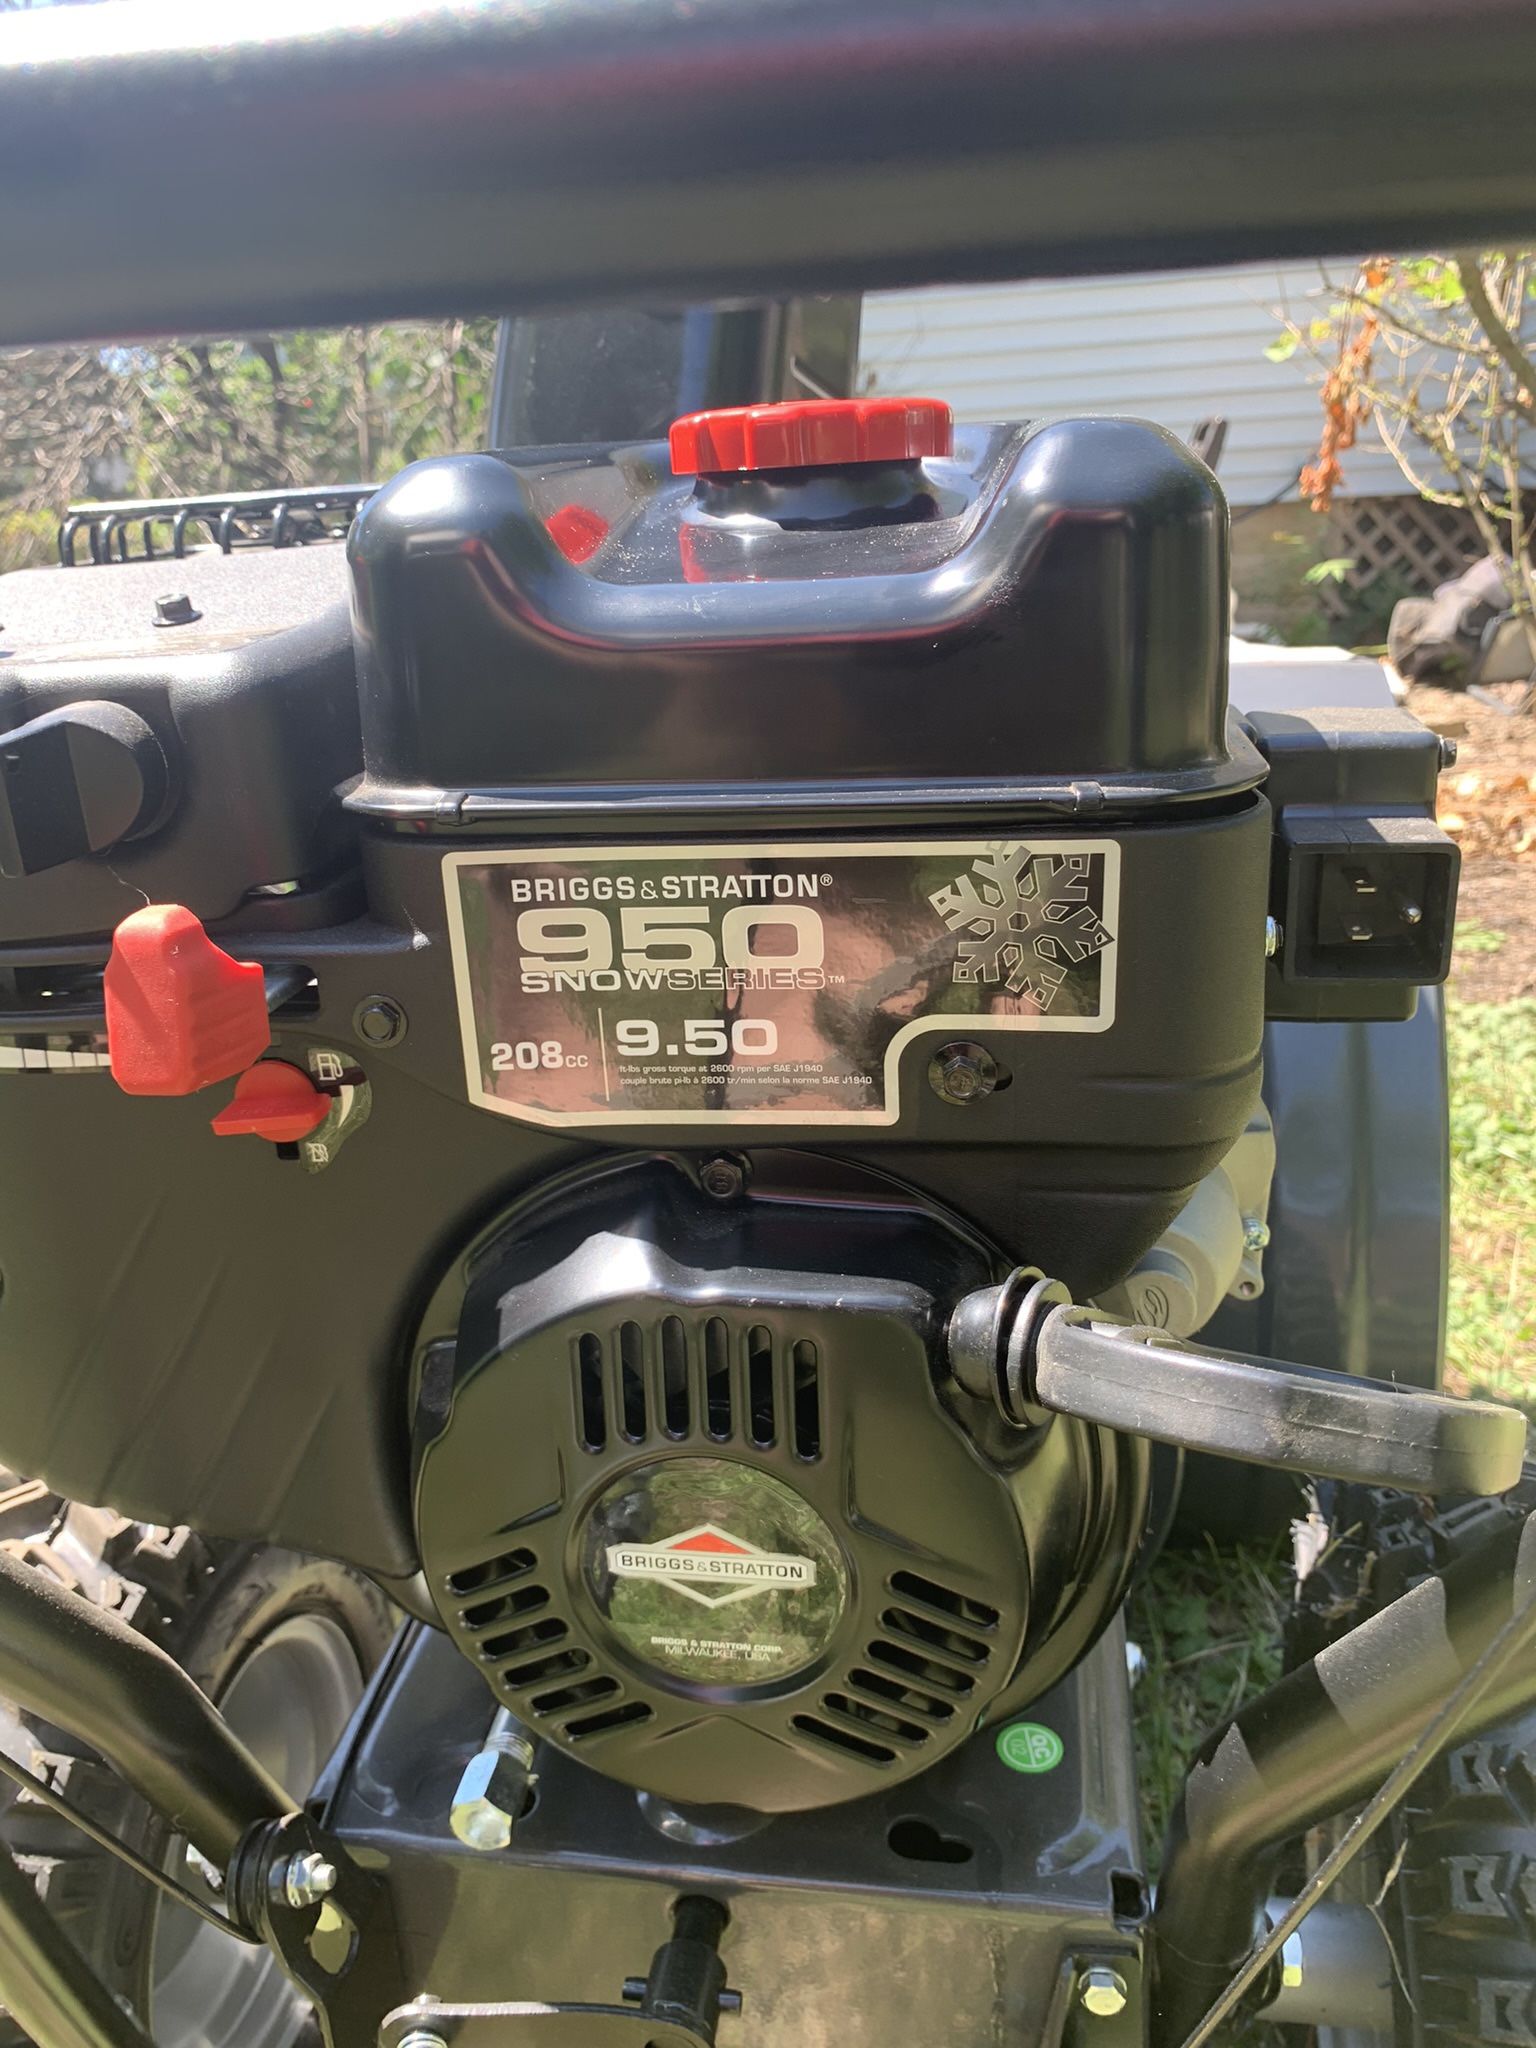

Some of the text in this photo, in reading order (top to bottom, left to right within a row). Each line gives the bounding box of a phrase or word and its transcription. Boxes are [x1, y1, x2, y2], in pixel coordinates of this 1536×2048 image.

[516, 904, 825, 977] 950
[615, 1019, 778, 1057] 9.50
[668, 1066, 696, 1074] torque
[698, 1065, 708, 1073] at
[710, 1064, 735, 1073] 2600
[736, 1066, 755, 1074] rpm
[756, 1066, 771, 1074] per
[773, 1064, 791, 1073] SAE
[793, 1064, 823, 1073] J1940
[620, 1077, 648, 1086] couple
[649, 1077, 672, 1085] brute
[701, 1076, 725, 1085] 2600
[727, 1076, 756, 1085] tr/min
[758, 1076, 781, 1084] selon
[782, 1076, 791, 1084] la
[792, 1077, 820, 1085] norme
[822, 1076, 840, 1085] SAE
[842, 1076, 873, 1085] J1940
[651, 1636, 688, 1646] BRIGGS
[700, 1640, 752, 1651] STRATTON
